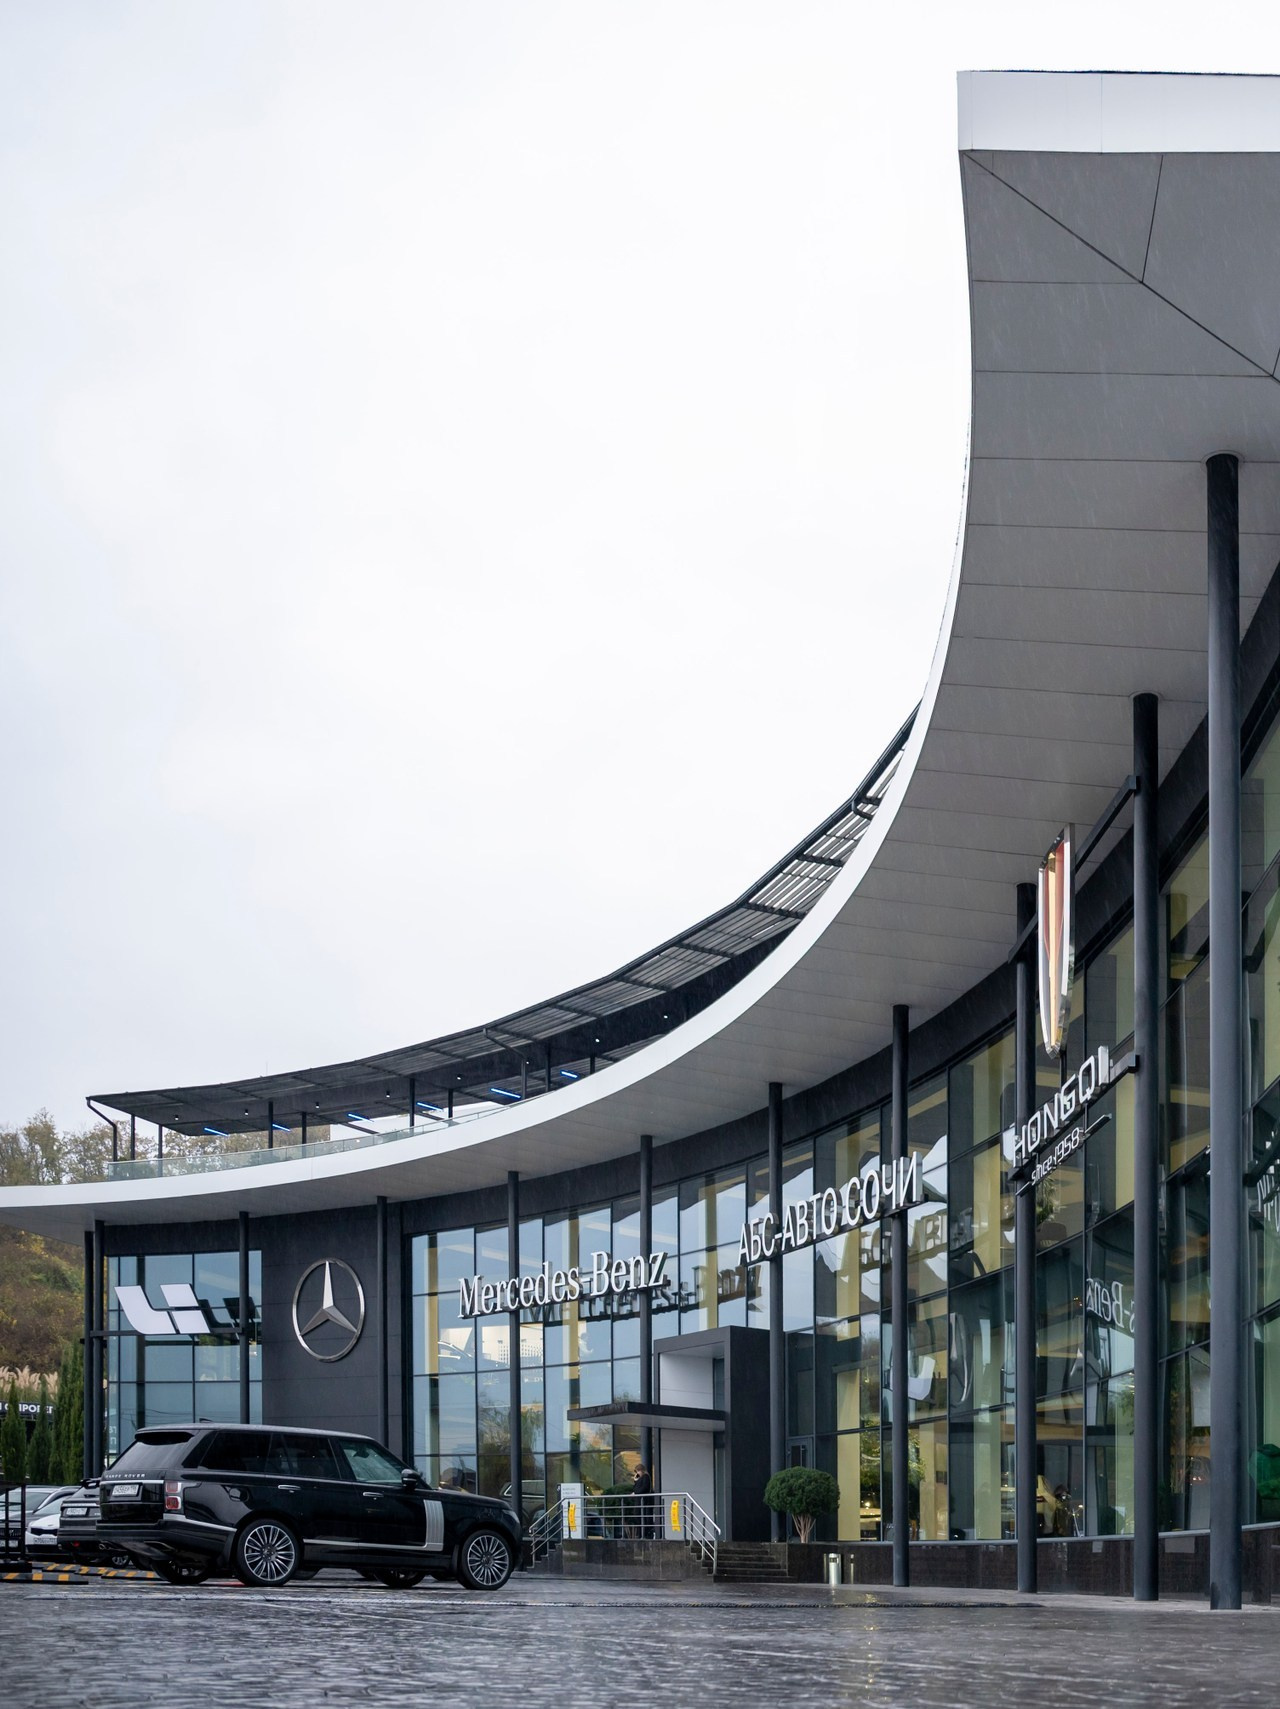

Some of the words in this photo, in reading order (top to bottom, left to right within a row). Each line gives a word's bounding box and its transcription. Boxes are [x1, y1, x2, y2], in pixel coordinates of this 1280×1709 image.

[1013, 1045, 1109, 1169] HONGQI
[1031, 1156, 1053, 1186] since
[1052, 1127, 1081, 1165] 1958
[738, 1187, 838, 1266] АБС-АВТО
[846, 1151, 920, 1226] СОЧИ
[457, 1250, 668, 1319] Mercedes-Benz
